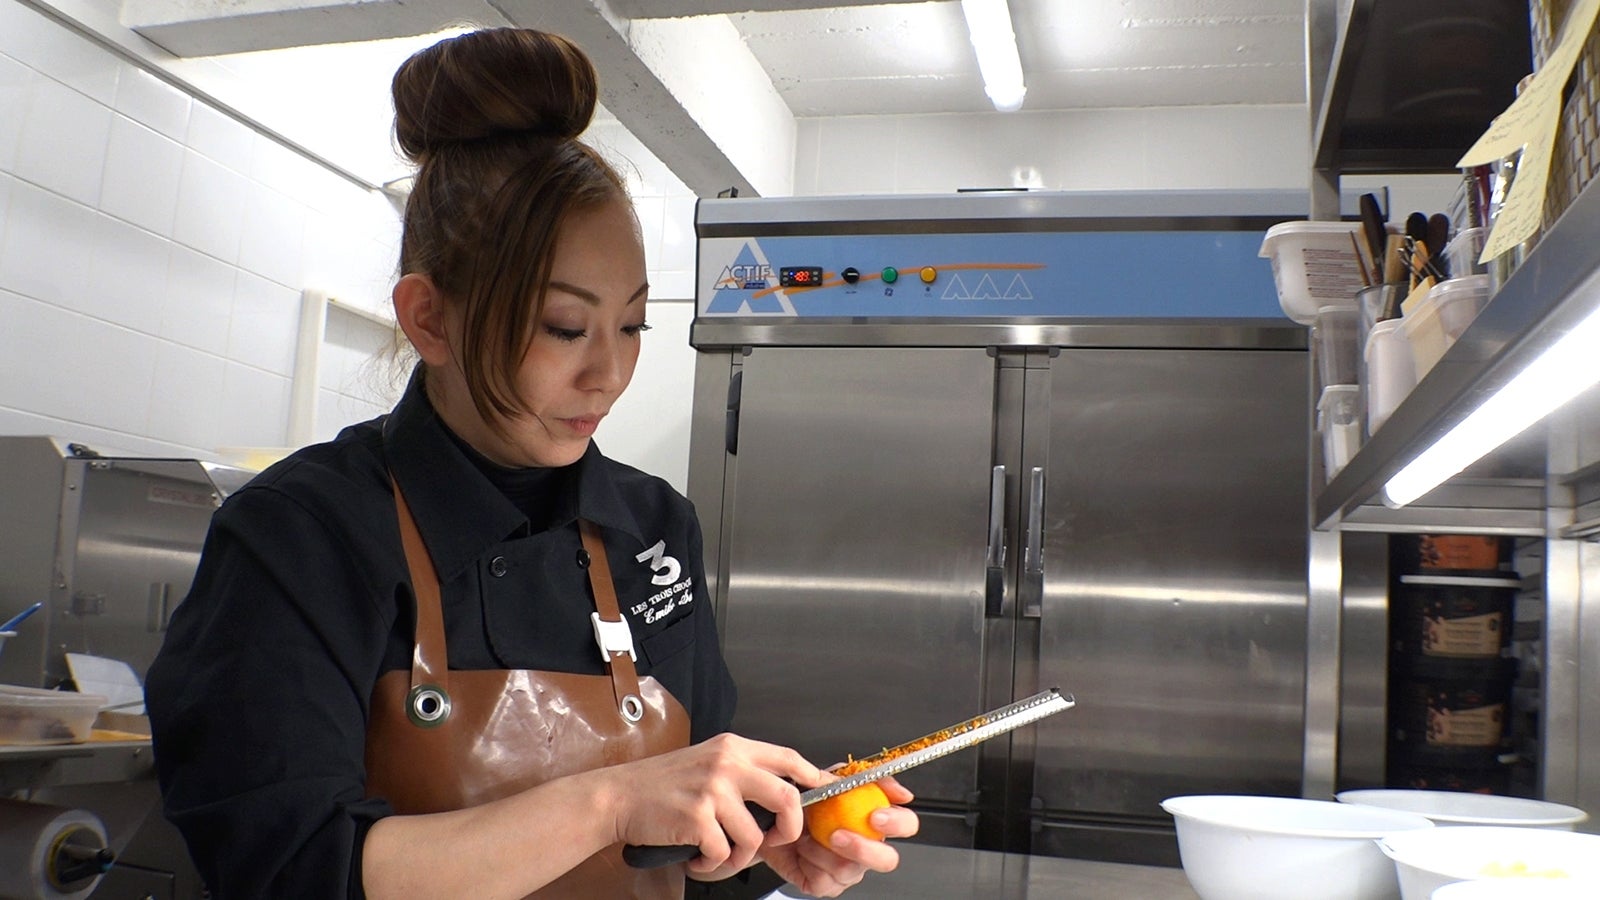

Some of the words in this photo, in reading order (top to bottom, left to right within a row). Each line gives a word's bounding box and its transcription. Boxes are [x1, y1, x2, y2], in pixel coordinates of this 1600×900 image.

[635, 538, 682, 586] 3
[630, 601, 649, 615] LES
[648, 587, 673, 605] TROIS
